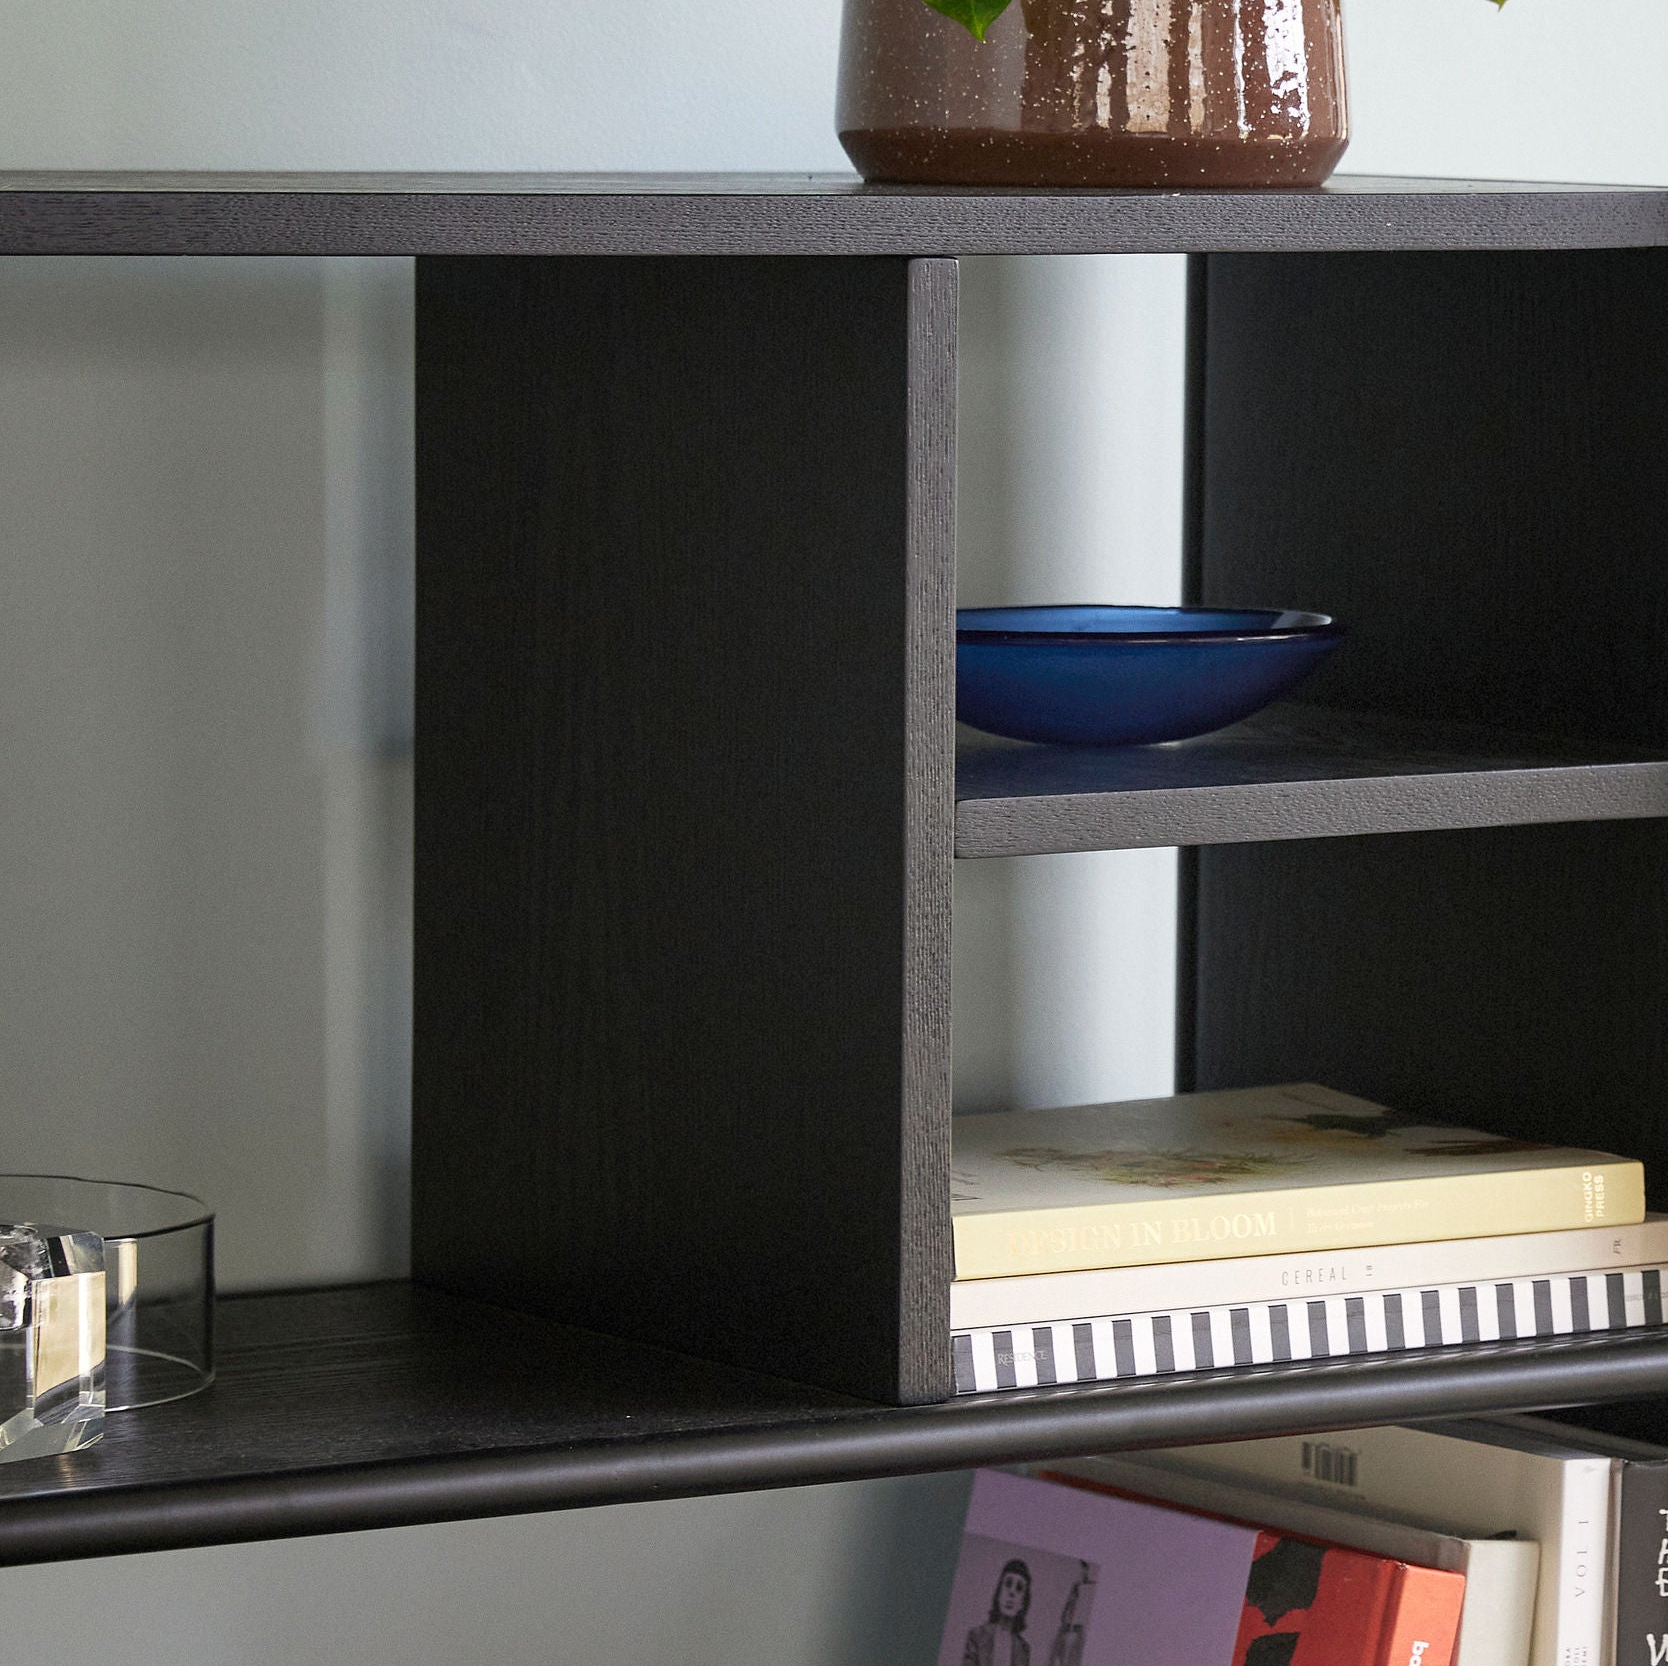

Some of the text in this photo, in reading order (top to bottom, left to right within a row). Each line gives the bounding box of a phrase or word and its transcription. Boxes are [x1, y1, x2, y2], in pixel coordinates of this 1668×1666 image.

[1582, 1171, 1593, 1223] GINGKO
[1593, 1175, 1605, 1218] PRESS
[1130, 1221, 1162, 1247] IN
[1171, 1211, 1278, 1244] BLOOM
[1281, 1265, 1347, 1286] CEREAL
[1575, 1545, 1587, 1597] VOL
